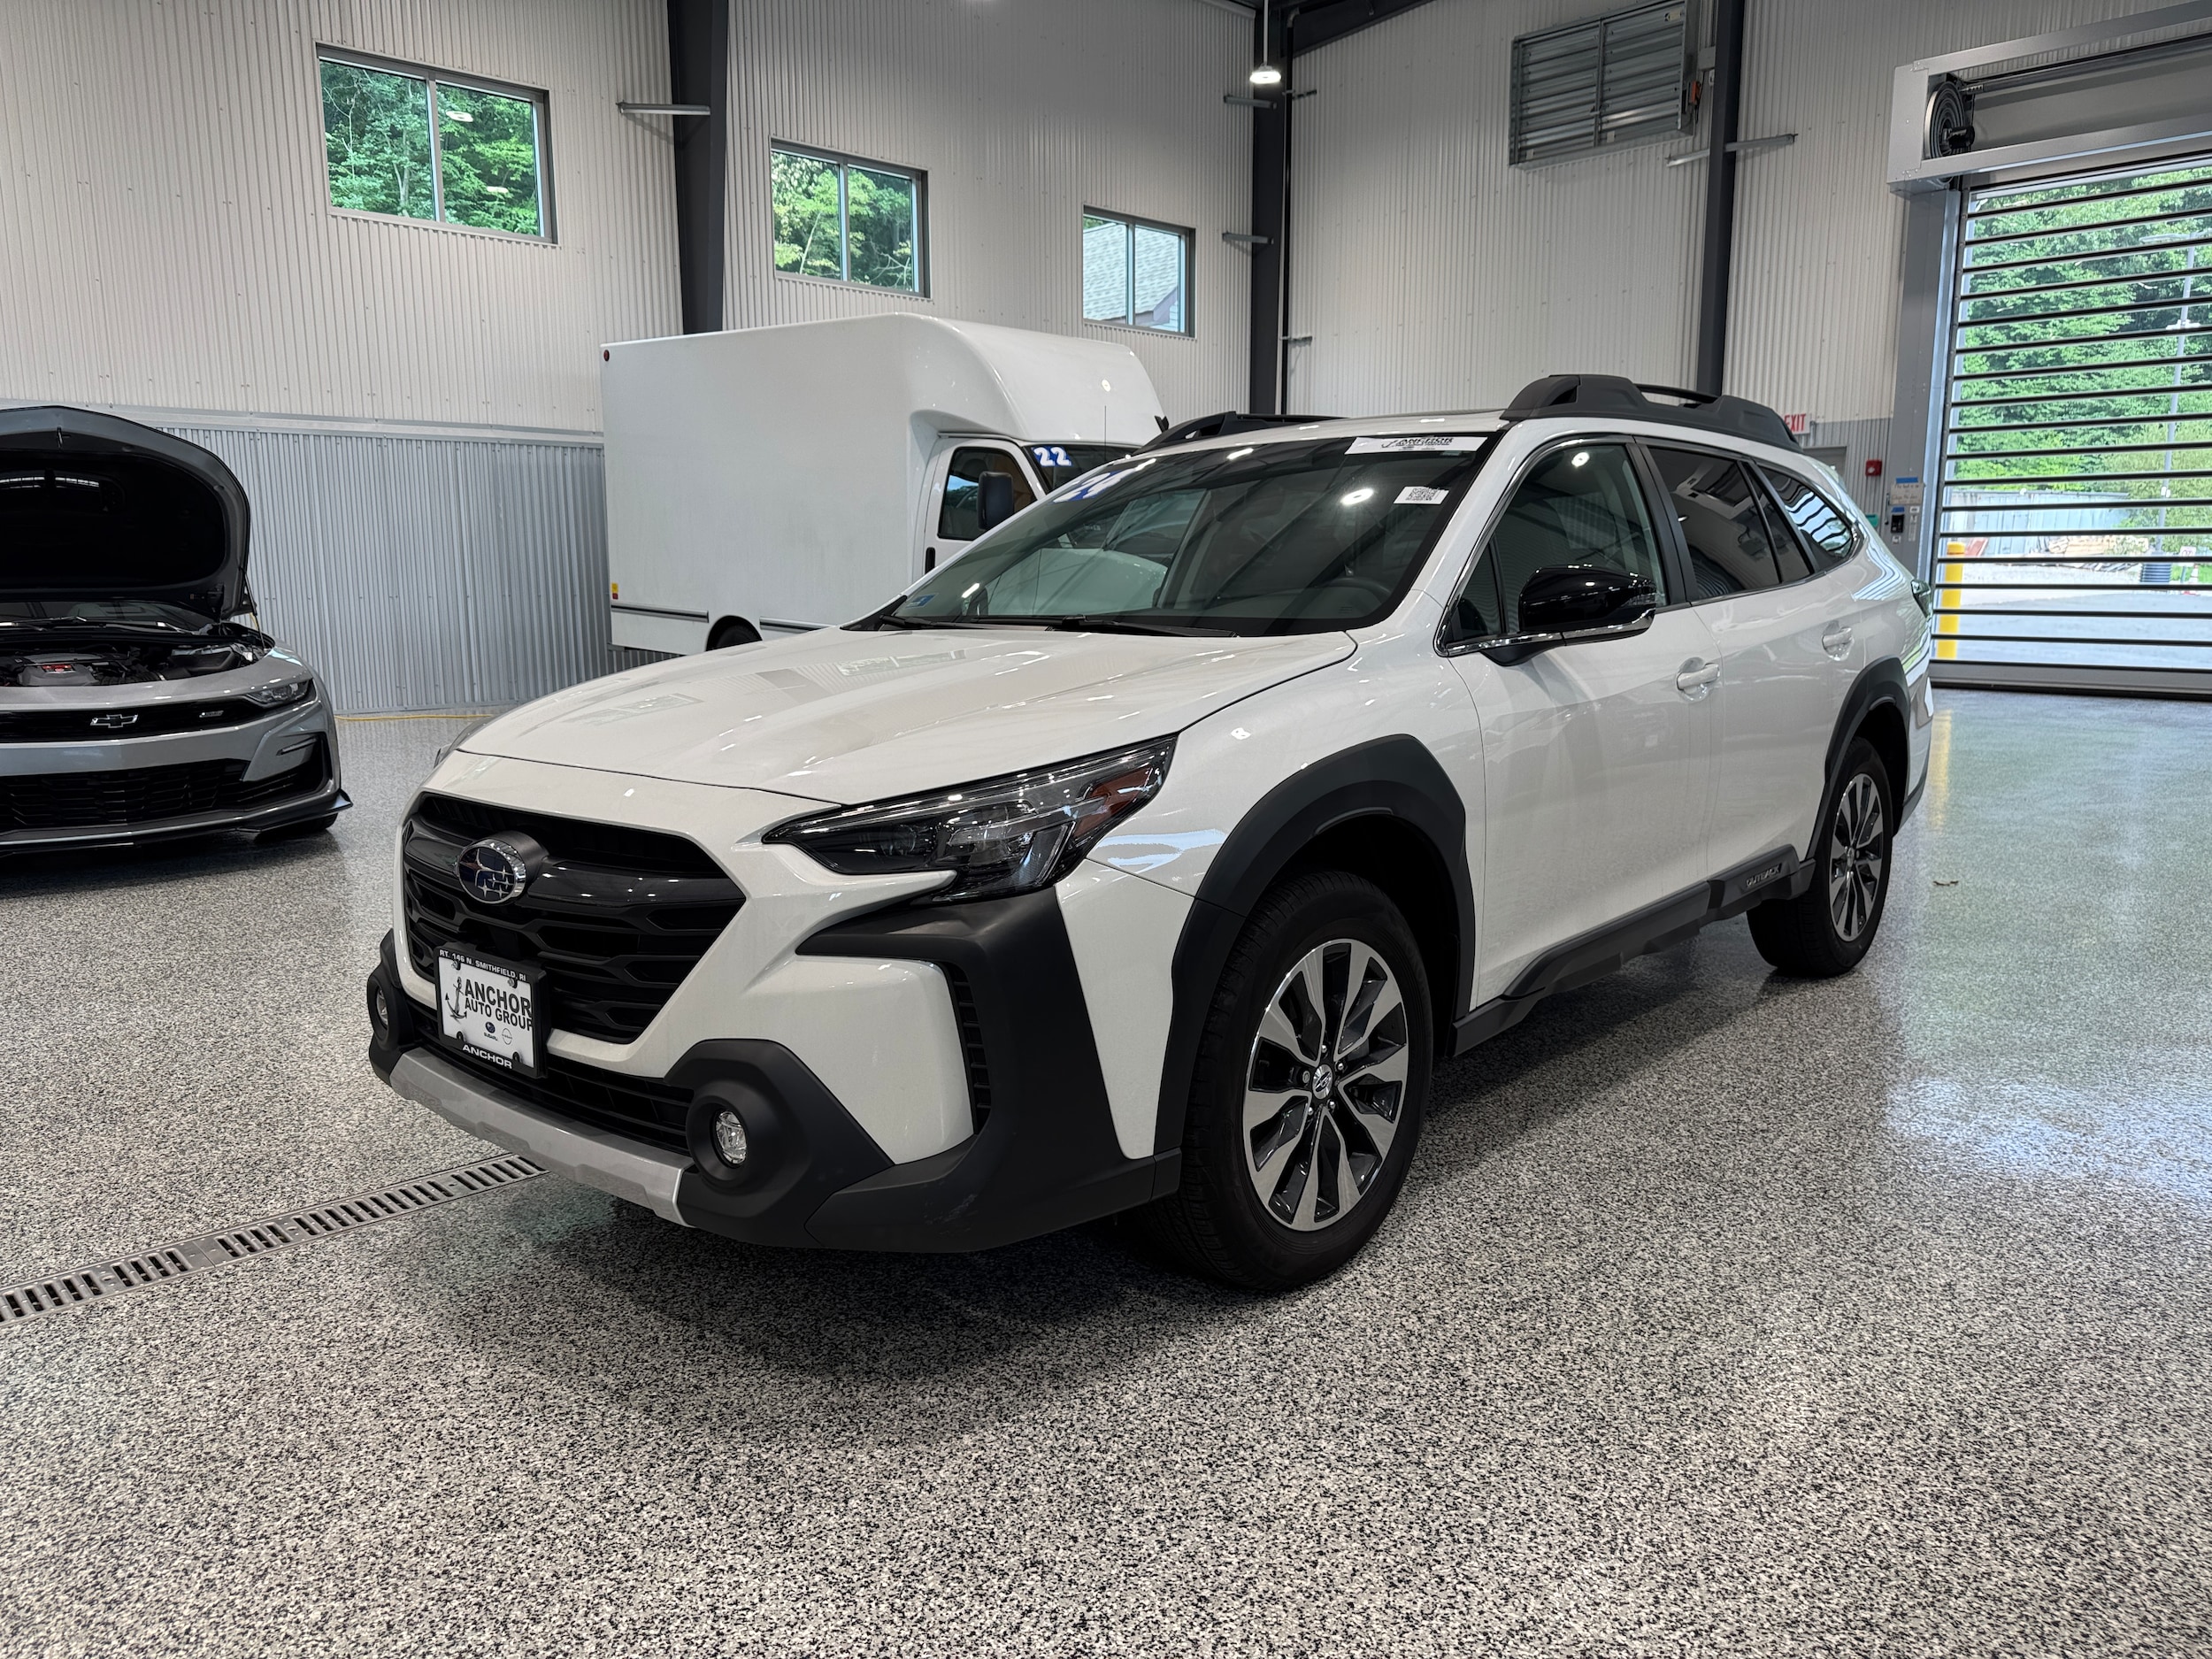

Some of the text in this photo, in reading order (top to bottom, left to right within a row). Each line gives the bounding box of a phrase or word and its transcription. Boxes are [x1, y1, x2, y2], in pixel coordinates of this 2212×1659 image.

[1784, 412, 1807, 432] EXIT
[1033, 447, 1072, 466] 22
[452, 953, 465, 963] 146
[465, 979, 533, 1018] ANCHOR
[465, 997, 533, 1031] AUTO GROUP
[462, 1044, 513, 1069] ANCHOR
